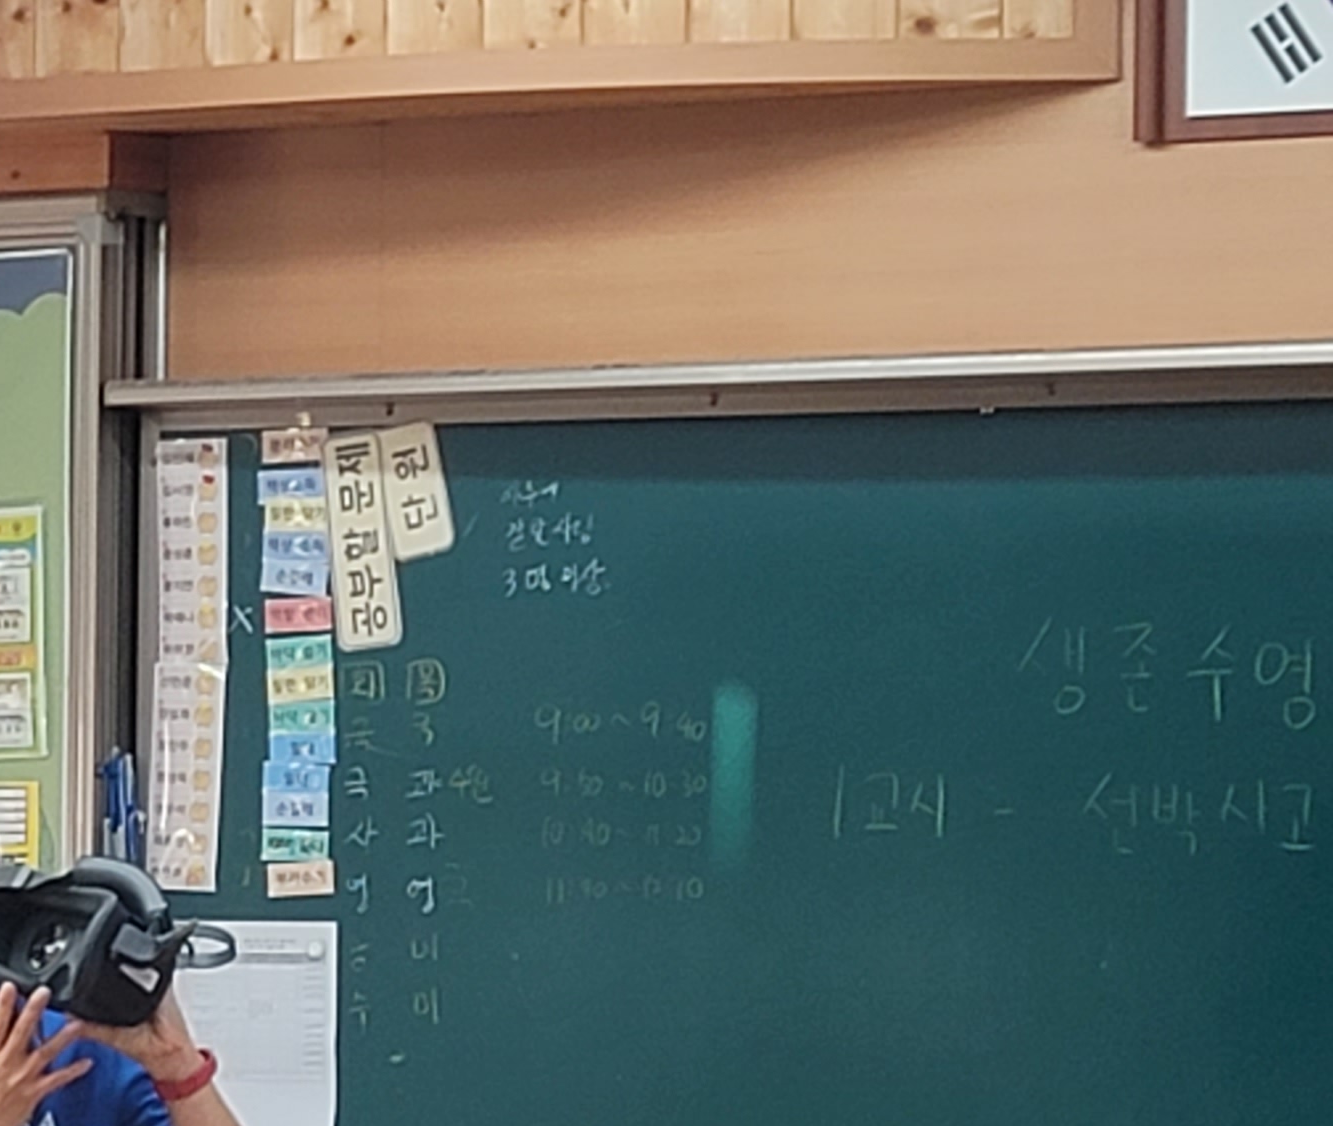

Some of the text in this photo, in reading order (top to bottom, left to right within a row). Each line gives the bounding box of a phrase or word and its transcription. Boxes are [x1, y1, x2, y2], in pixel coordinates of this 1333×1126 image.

[390, 444, 439, 530] 단원
[335, 440, 387, 637] 공부할 문제
[1018, 616, 1317, 730] 생존수영
[833, 763, 945, 838] 1교시
